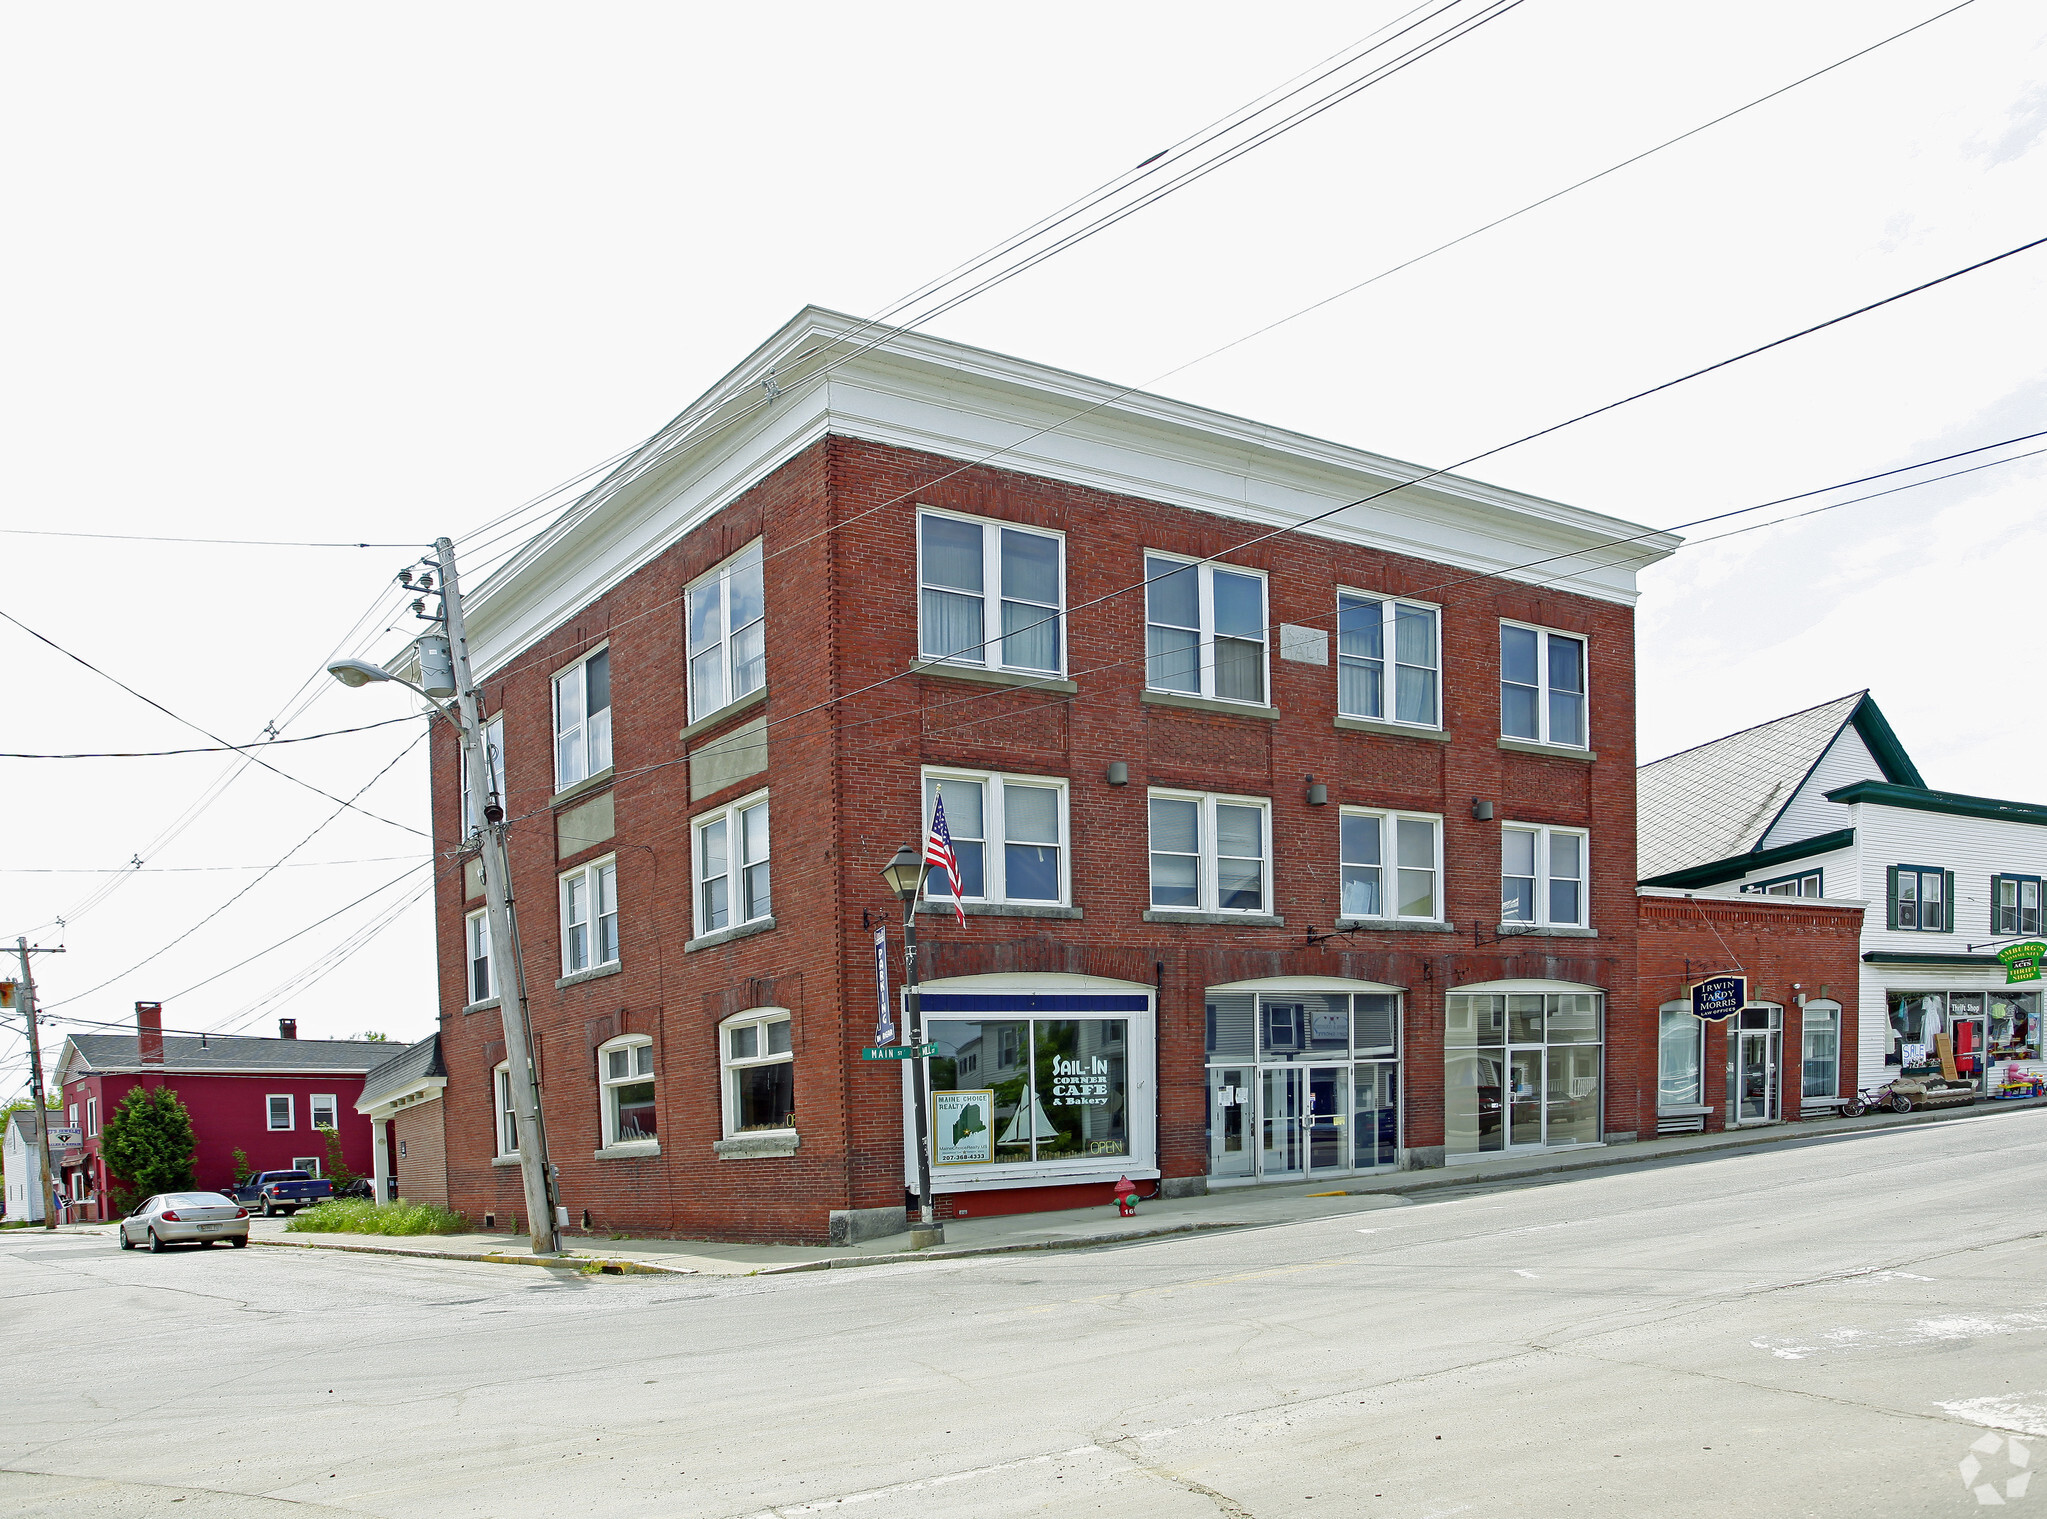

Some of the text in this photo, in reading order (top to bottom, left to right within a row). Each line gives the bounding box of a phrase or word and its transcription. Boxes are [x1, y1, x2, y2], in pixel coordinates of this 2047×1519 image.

[2010, 966, 2037, 975] THRIFT
[2012, 972, 2035, 980] SHOP
[878, 948, 888, 1025] PARKING
[1701, 980, 1735, 993] IRWIN
[1701, 989, 1735, 1002] TARDY
[1700, 998, 1737, 1011] MORRIS
[1951, 1004, 1980, 1013] Thrift Shop
[871, 1049, 894, 1059] MAIN
[1903, 1044, 1924, 1058] SALE
[1053, 1076, 1108, 1085] CORNER
[1052, 1084, 1108, 1097] CAFE
[1052, 1097, 1109, 1106] & Bakery
[1090, 1140, 1123, 1155] OPEN
